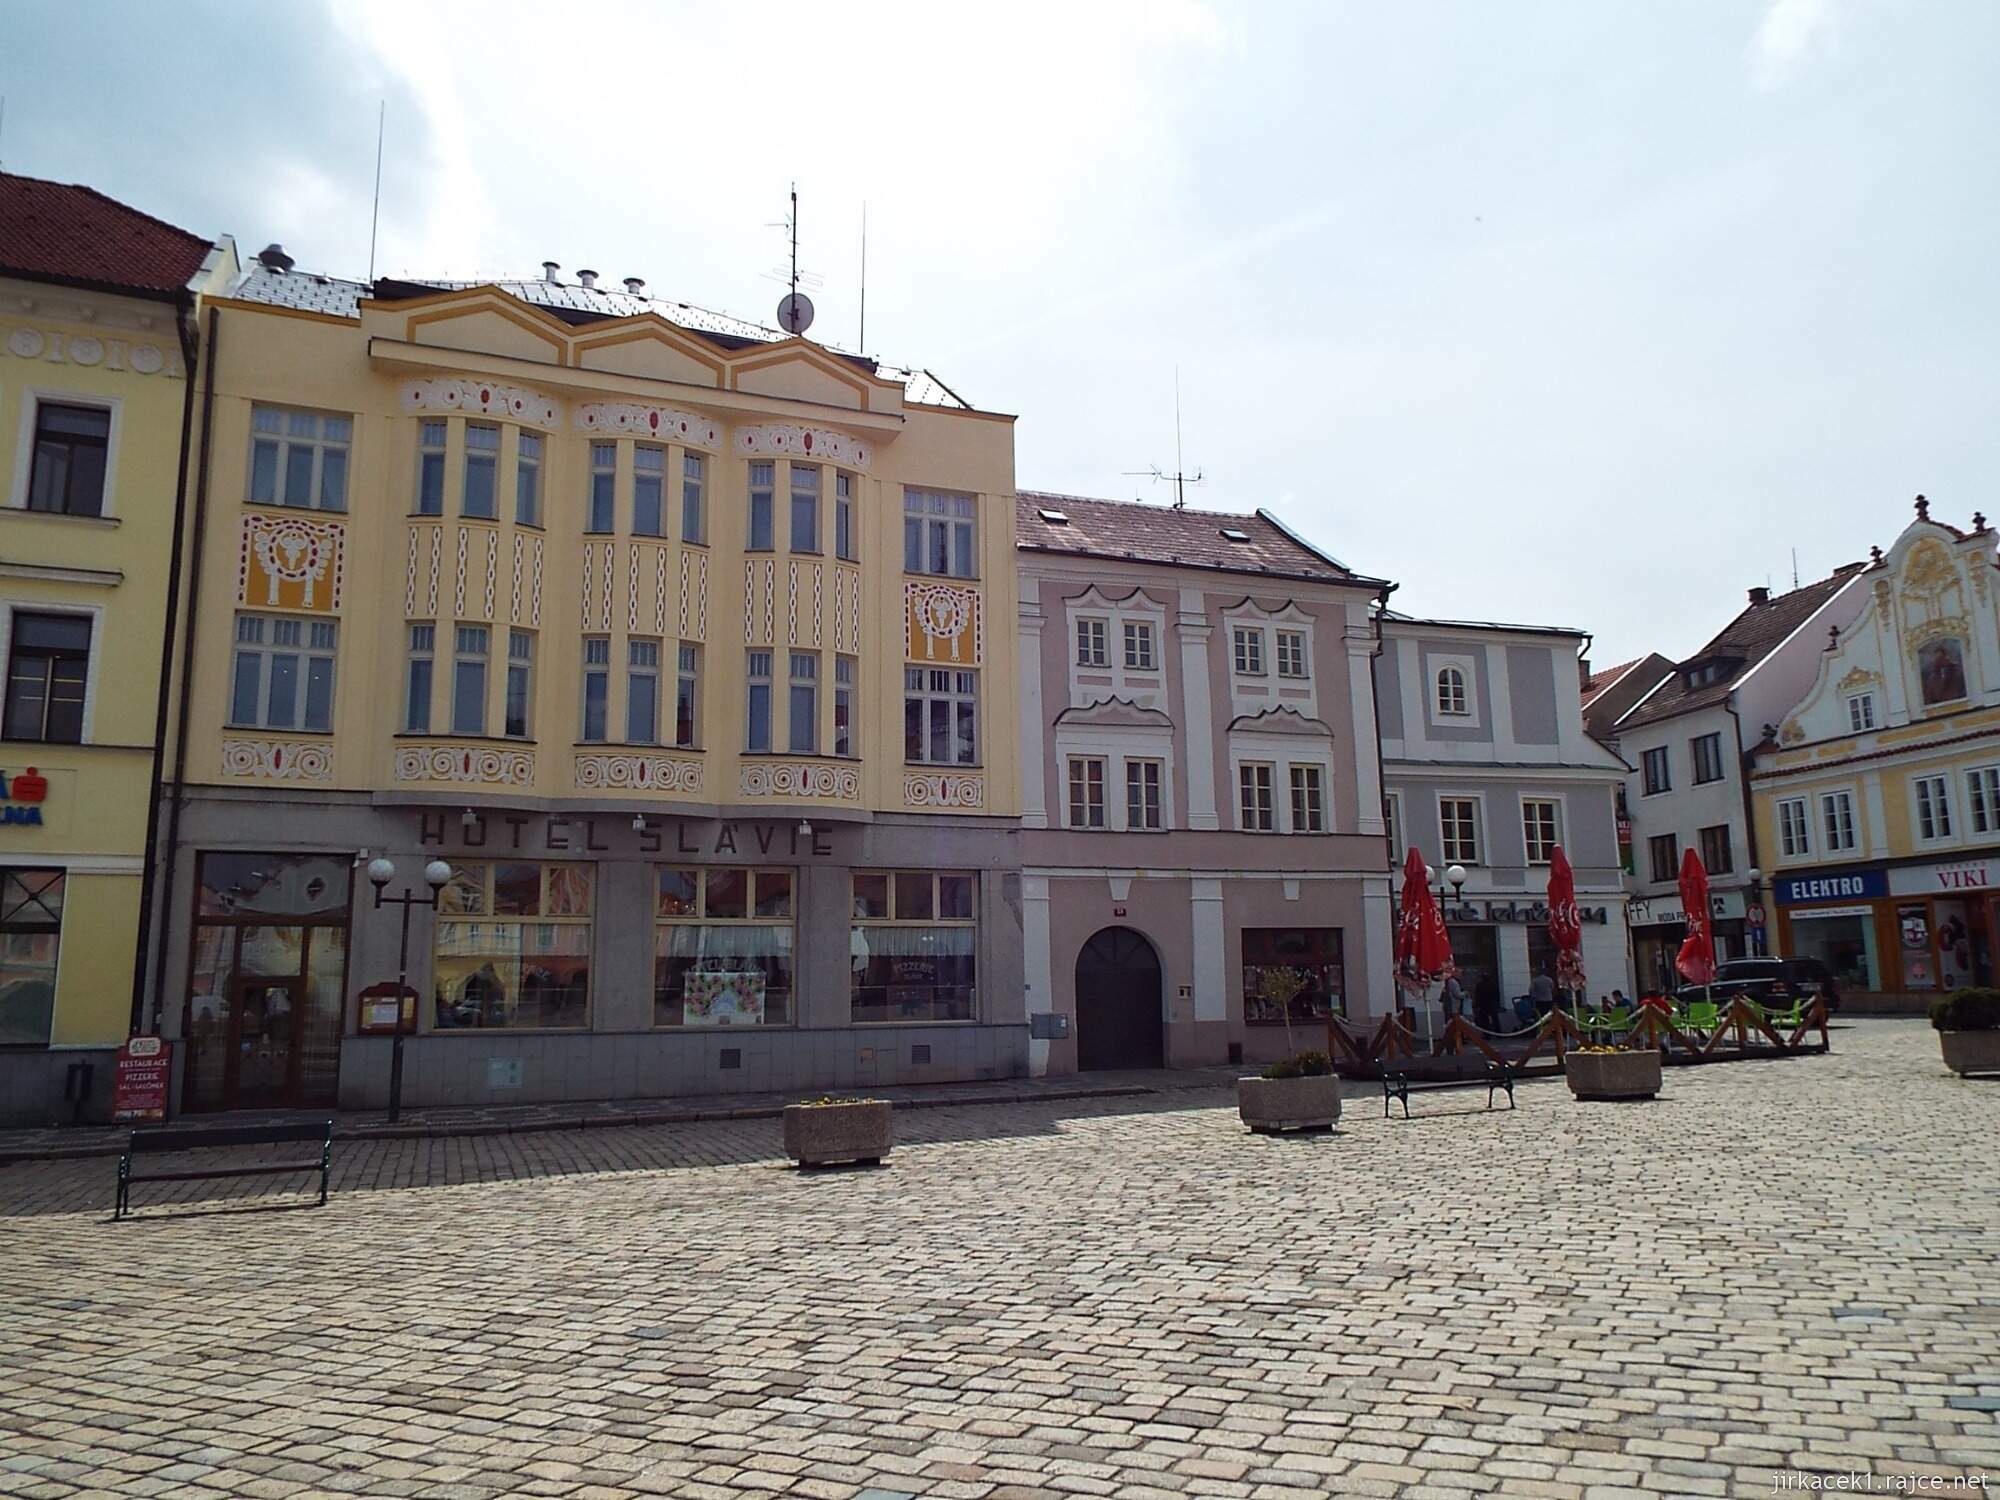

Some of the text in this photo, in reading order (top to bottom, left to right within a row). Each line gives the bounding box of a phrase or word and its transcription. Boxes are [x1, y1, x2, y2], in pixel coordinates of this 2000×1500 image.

[420, 813, 609, 851] HOTEL
[1791, 877, 1864, 899] ELEKTRO
[1936, 869, 1989, 888] VIKI
[120, 1058, 168, 1068] RESTAURACE
[125, 1072, 159, 1081] PIZZERIE
